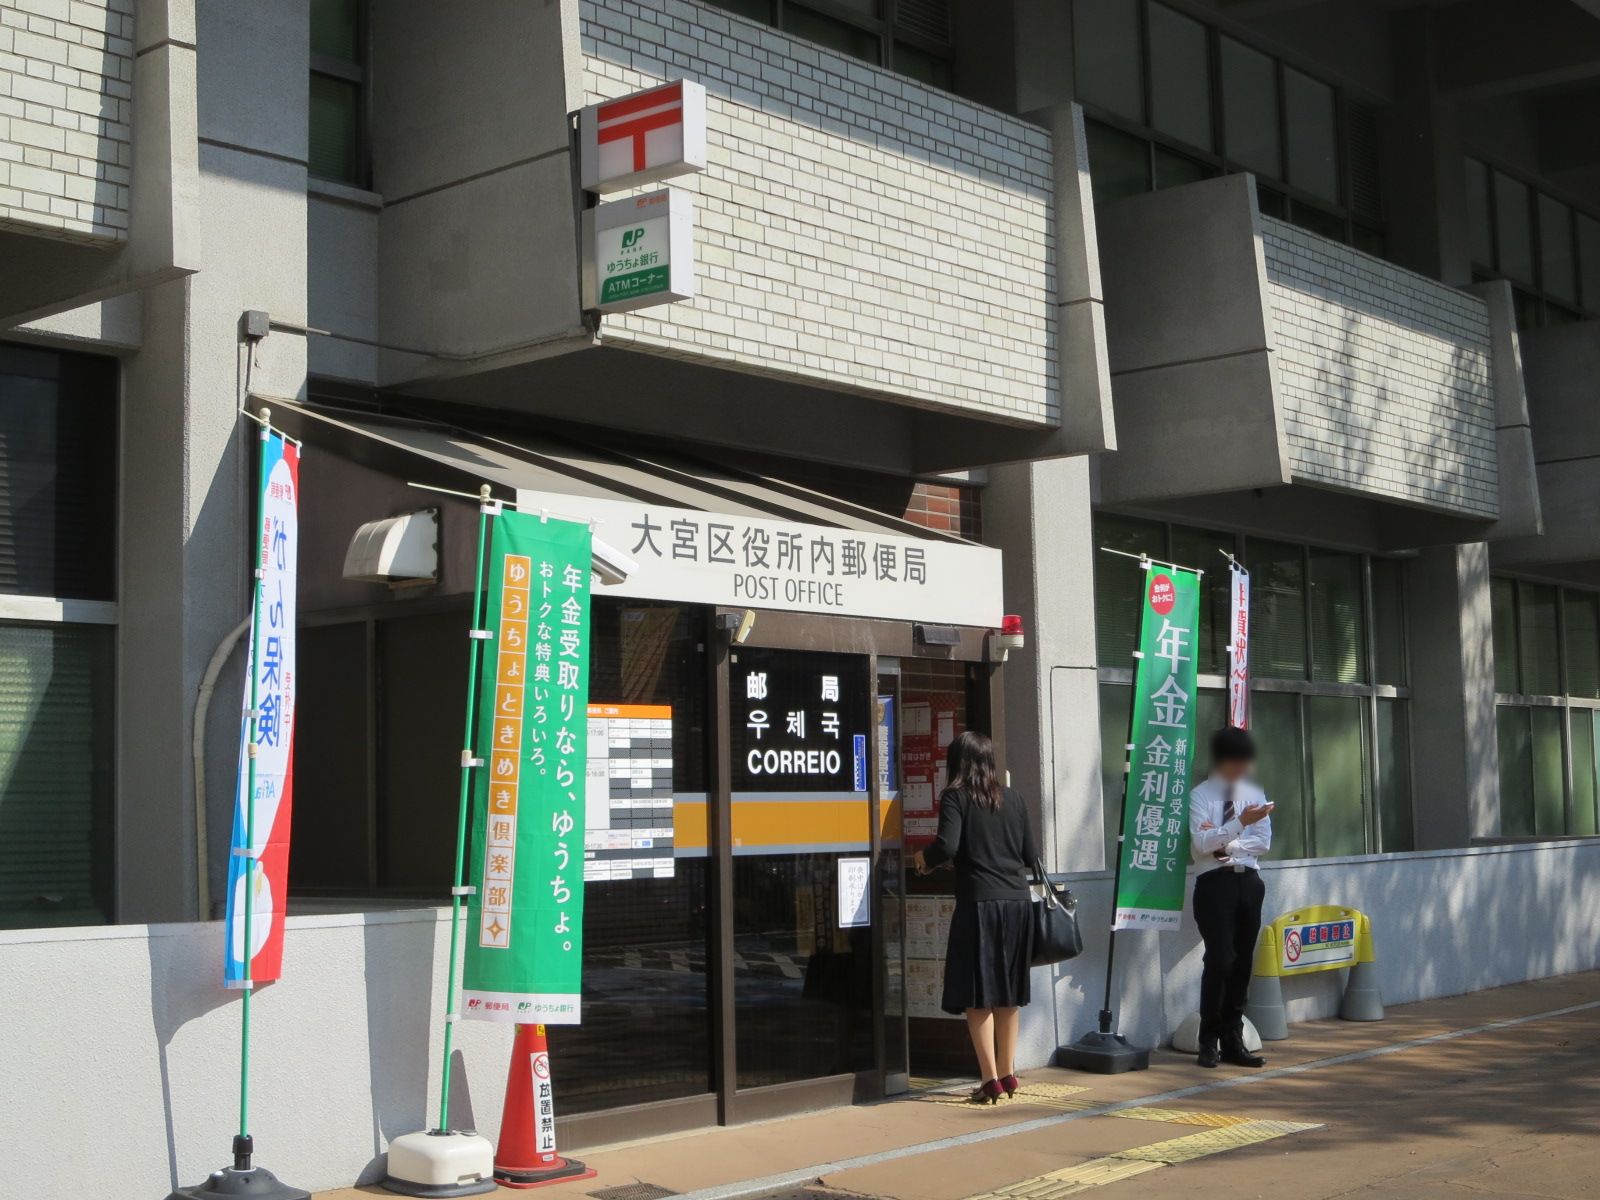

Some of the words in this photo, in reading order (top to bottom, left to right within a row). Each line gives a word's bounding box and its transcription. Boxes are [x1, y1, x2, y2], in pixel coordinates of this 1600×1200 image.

[606, 251, 659, 274] ゆうちょ銀行
[608, 272, 664, 293] ATMコーナー
[630, 512, 927, 586] 大宮区役所内郵便局
[733, 573, 778, 601] POST
[785, 577, 844, 607] OFFICE
[529, 560, 554, 776] おトクな特典いろいろ。
[487, 563, 525, 907] ゆうちょときめき倶楽部
[550, 563, 583, 952] 年金受取りなら、ゆうちょ。
[746, 749, 842, 775] CORREIO
[1163, 737, 1188, 872] 新規お受取りで
[484, 1001, 510, 1011] 郵便局
[534, 1003, 575, 1013] ゆうちょ銀行
[539, 1082, 554, 1150] 放置禁止
